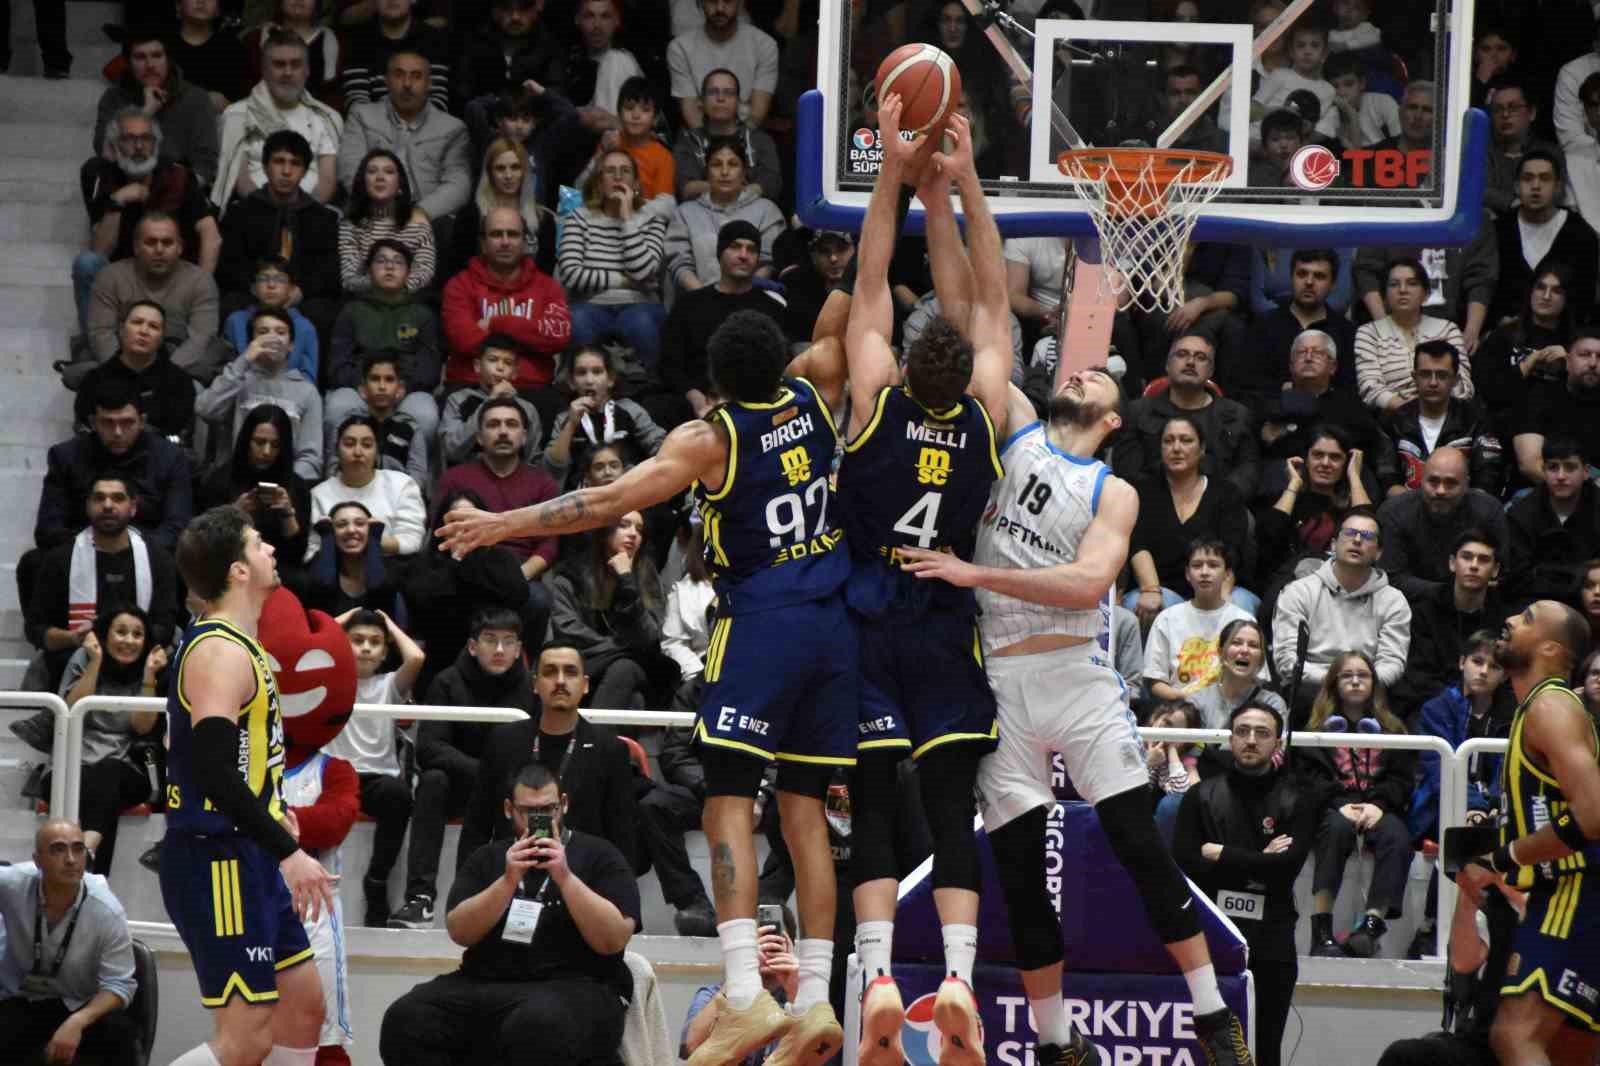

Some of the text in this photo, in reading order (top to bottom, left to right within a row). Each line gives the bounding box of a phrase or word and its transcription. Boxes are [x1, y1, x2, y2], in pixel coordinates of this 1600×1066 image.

[850, 149, 884, 161] BASK
[1342, 150, 1432, 188] TBF
[760, 412, 815, 453] BIRCH
[906, 420, 968, 449] MELLI
[765, 476, 829, 548] 92
[1017, 473, 1052, 515] 19
[893, 491, 942, 548] 4
[738, 715, 770, 735] ENEZ
[857, 715, 896, 734] ENEZ
[237, 729, 249, 784] ADEMY
[1045, 803, 1065, 922] SiGORT
[1224, 896, 1256, 913] 600
[996, 996, 1198, 1040] TRKiYE
